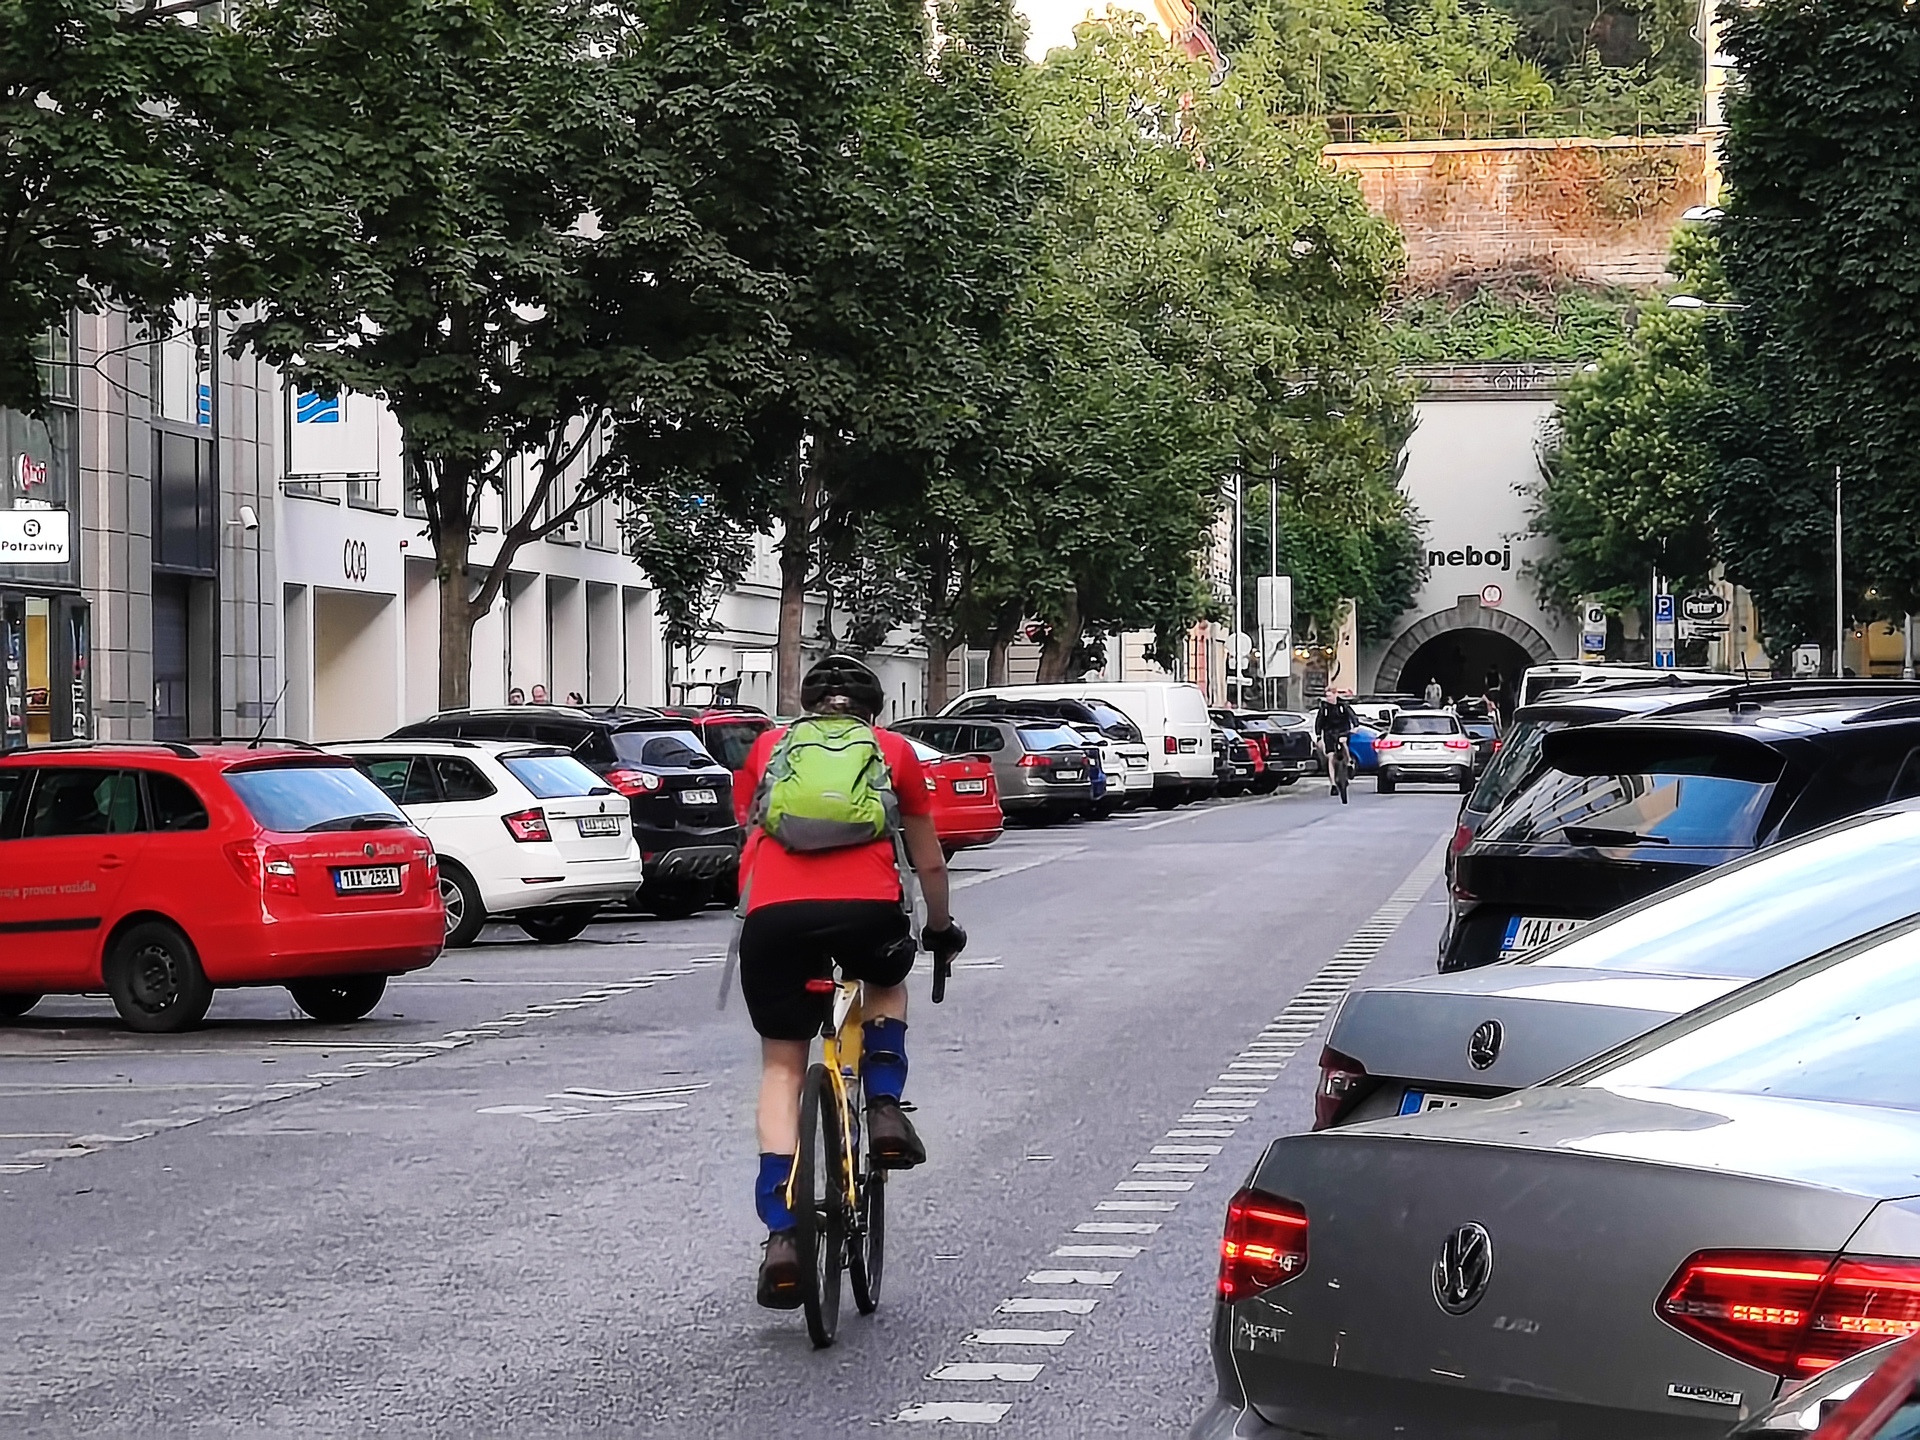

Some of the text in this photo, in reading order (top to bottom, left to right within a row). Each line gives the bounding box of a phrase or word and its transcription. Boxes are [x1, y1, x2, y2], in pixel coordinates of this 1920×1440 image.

[1, 540, 64, 554] Potraviny
[1428, 544, 1511, 571] neboj
[1658, 598, 1670, 614] P
[22, 885, 57, 899] provoz
[59, 880, 97, 893] vozidla
